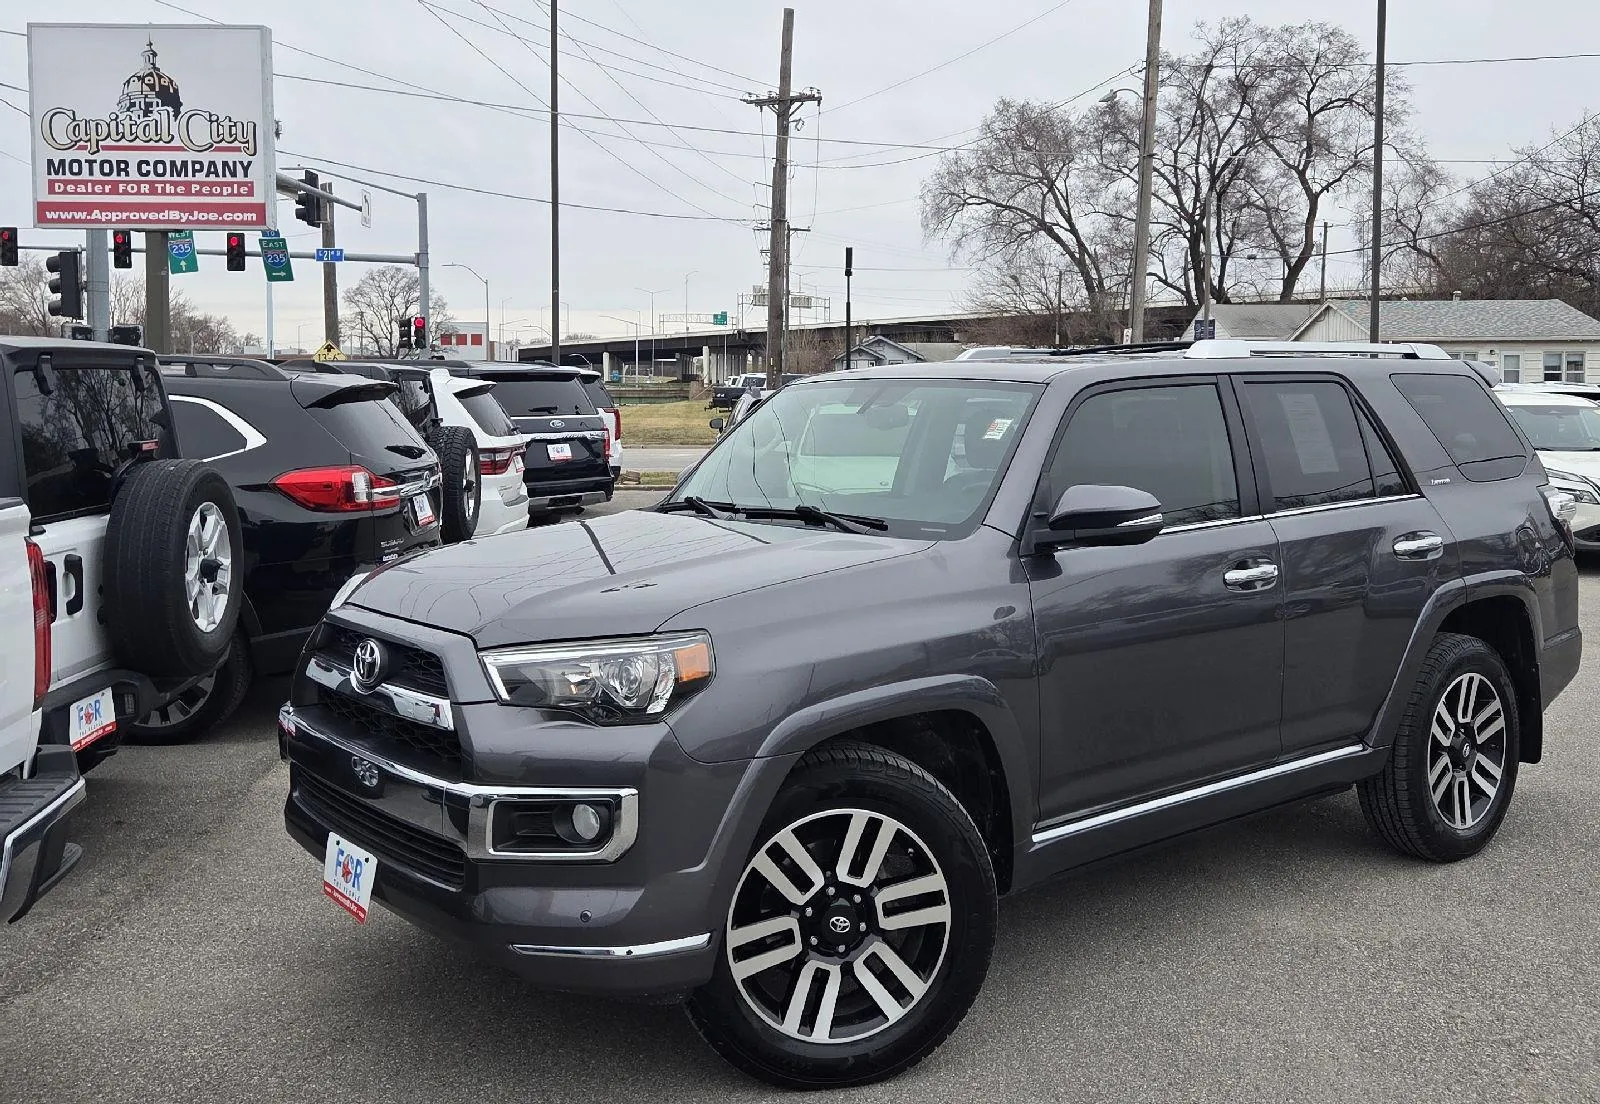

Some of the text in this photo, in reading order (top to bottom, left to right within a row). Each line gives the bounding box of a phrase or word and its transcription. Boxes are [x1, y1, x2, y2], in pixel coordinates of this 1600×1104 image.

[41, 107, 257, 156] Capital City
[46, 158, 253, 178] MOTOR COMPANY
[54, 182, 249, 197] Dealer FOR The People
[45, 209, 257, 222] www.ApprovedByJoe.com
[168, 230, 190, 238] WEST
[172, 244, 191, 254] 235
[267, 255, 286, 263] 235
